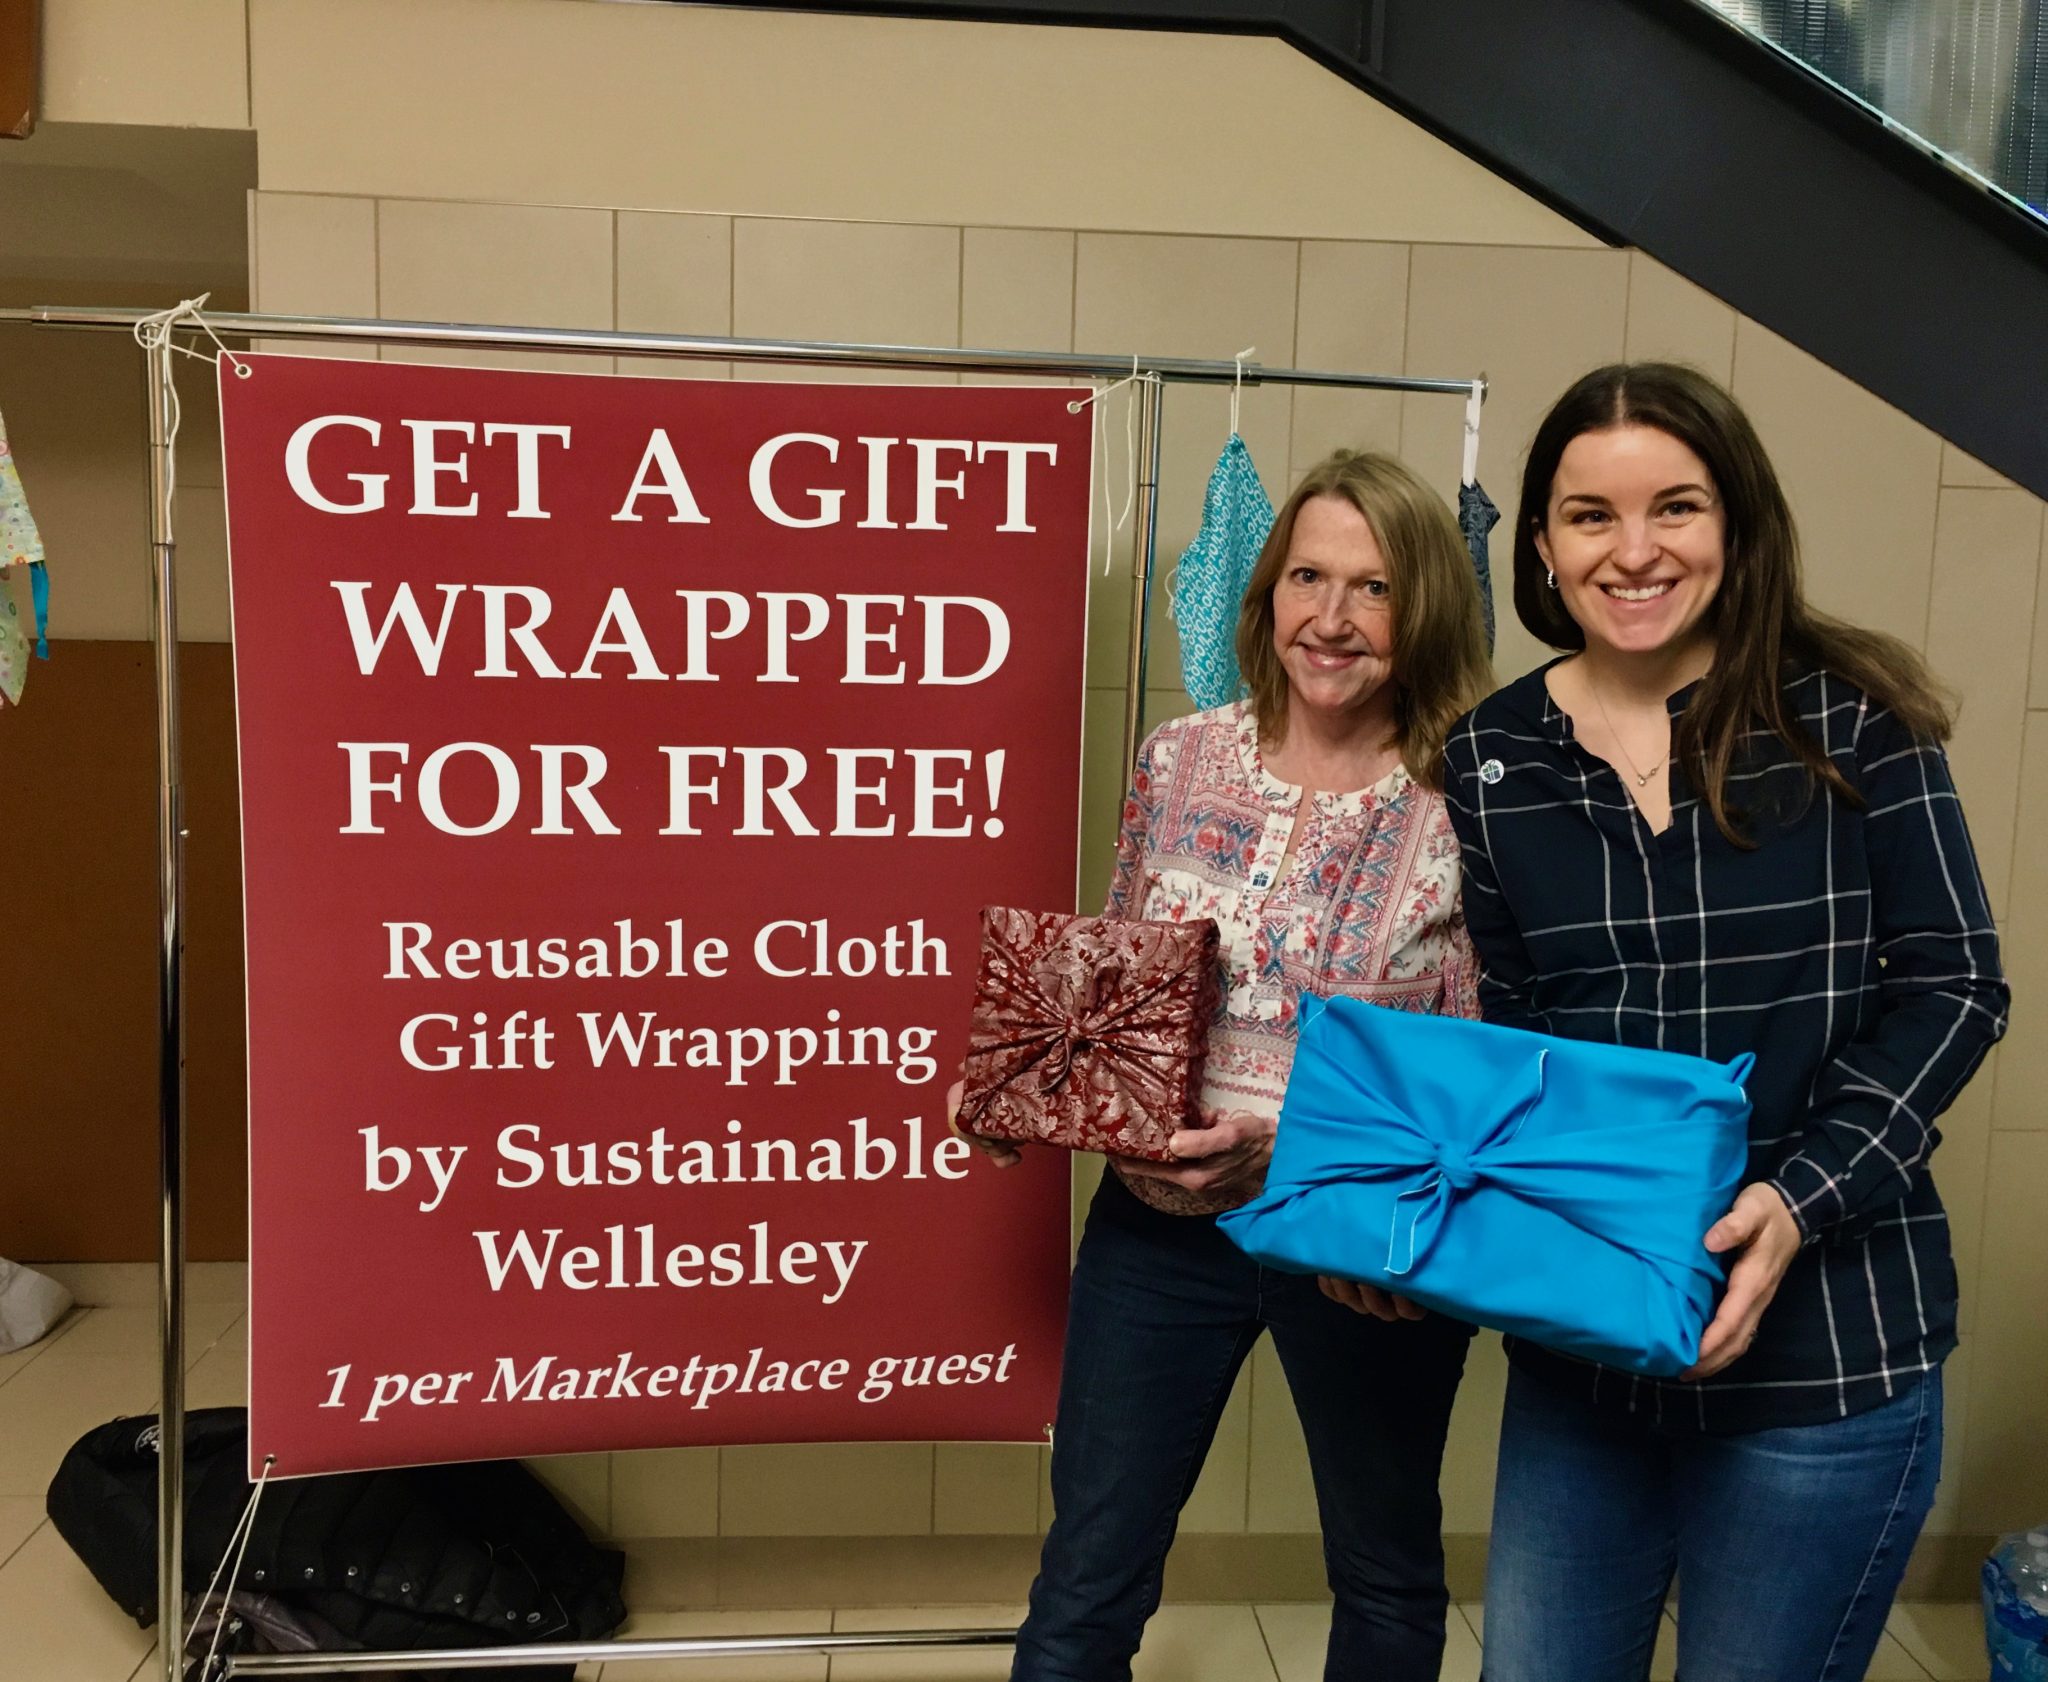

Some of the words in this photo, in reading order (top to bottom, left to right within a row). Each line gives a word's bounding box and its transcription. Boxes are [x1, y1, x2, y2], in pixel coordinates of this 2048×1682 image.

[285, 415, 572, 518] GET
[611, 429, 710, 524] A
[749, 433, 1058, 533] GIFT
[330, 581, 1011, 685] WRAPPED
[338, 742, 621, 836] FOR
[659, 746, 1006, 840] FREE!
[382, 919, 729, 980] Reusable
[754, 919, 951, 978] Cloth
[400, 1009, 555, 1072] Gift
[576, 1009, 938, 1085] Wrapping
[359, 1124, 469, 1212] by
[496, 1116, 971, 1189] Sustainable
[472, 1222, 868, 1304] Wellesley
[319, 1363, 352, 1408] 1
[358, 1372, 473, 1422] per
[480, 1347, 850, 1410] Marketplace
[857, 1343, 1018, 1403] guest
